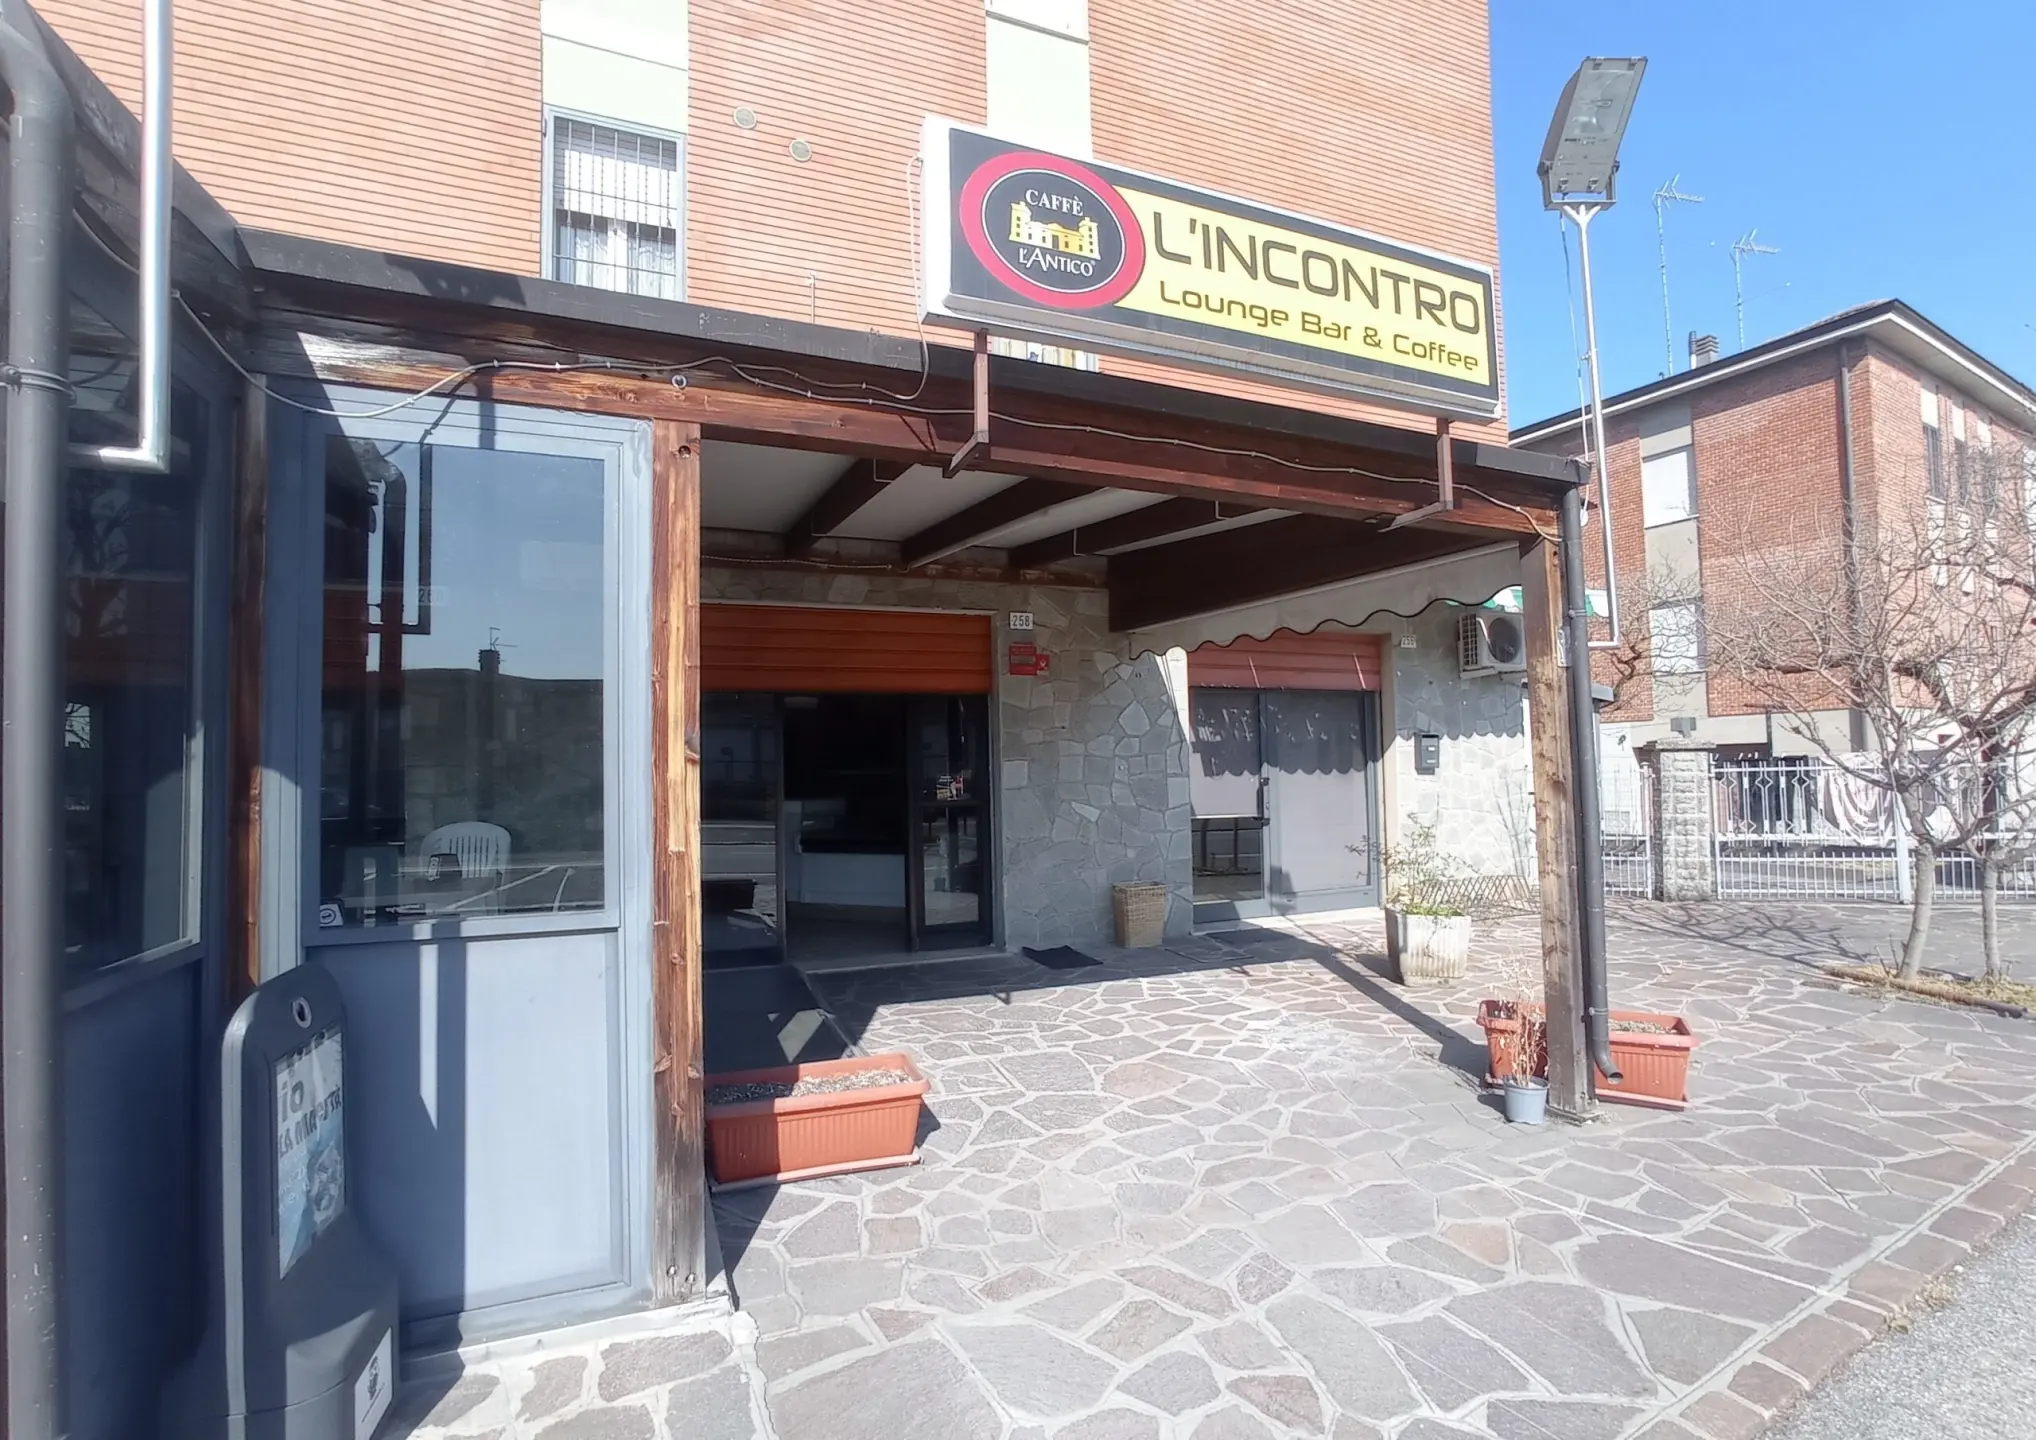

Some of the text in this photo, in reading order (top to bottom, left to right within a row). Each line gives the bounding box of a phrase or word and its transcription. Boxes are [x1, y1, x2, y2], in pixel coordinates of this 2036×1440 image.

[1025, 189, 1083, 216] CAFFÈ
[1019, 247, 1094, 277] L'ANTICO
[1153, 211, 1480, 335] L'INCONTRO
[1160, 280, 1478, 371] Lounge Bar & Coffee
[1012, 615, 1030, 627] 258
